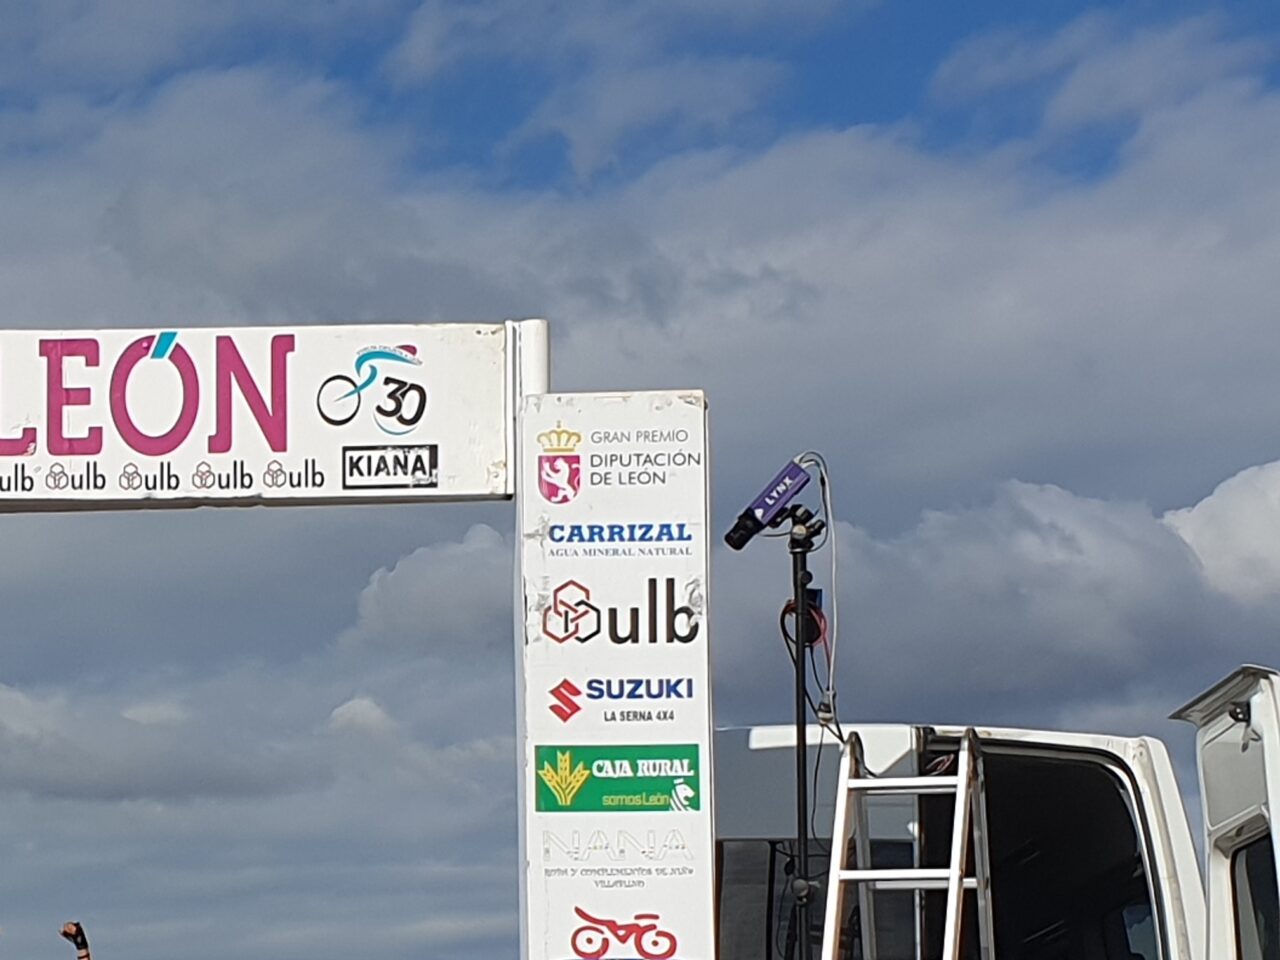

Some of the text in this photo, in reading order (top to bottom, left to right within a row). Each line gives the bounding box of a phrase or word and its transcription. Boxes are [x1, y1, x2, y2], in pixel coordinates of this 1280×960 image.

[375, 376, 427, 426] 30
[590, 429, 689, 443] GRAN PREMIO
[349, 454, 427, 477] KIANA
[590, 449, 701, 468] DIPUTACIÓN
[590, 467, 667, 486] DE LEÓN
[765, 476, 793, 505] LYNX
[548, 524, 693, 542] CARRIZAL
[548, 547, 693, 557] AGUA MINERAL NATURAL
[608, 578, 700, 643] ulb
[586, 678, 694, 699] SUZUKI
[604, 709, 675, 722] LA SERNA 4X4
[592, 758, 695, 778] CAJA RURAL
[542, 829, 695, 861] NANA
